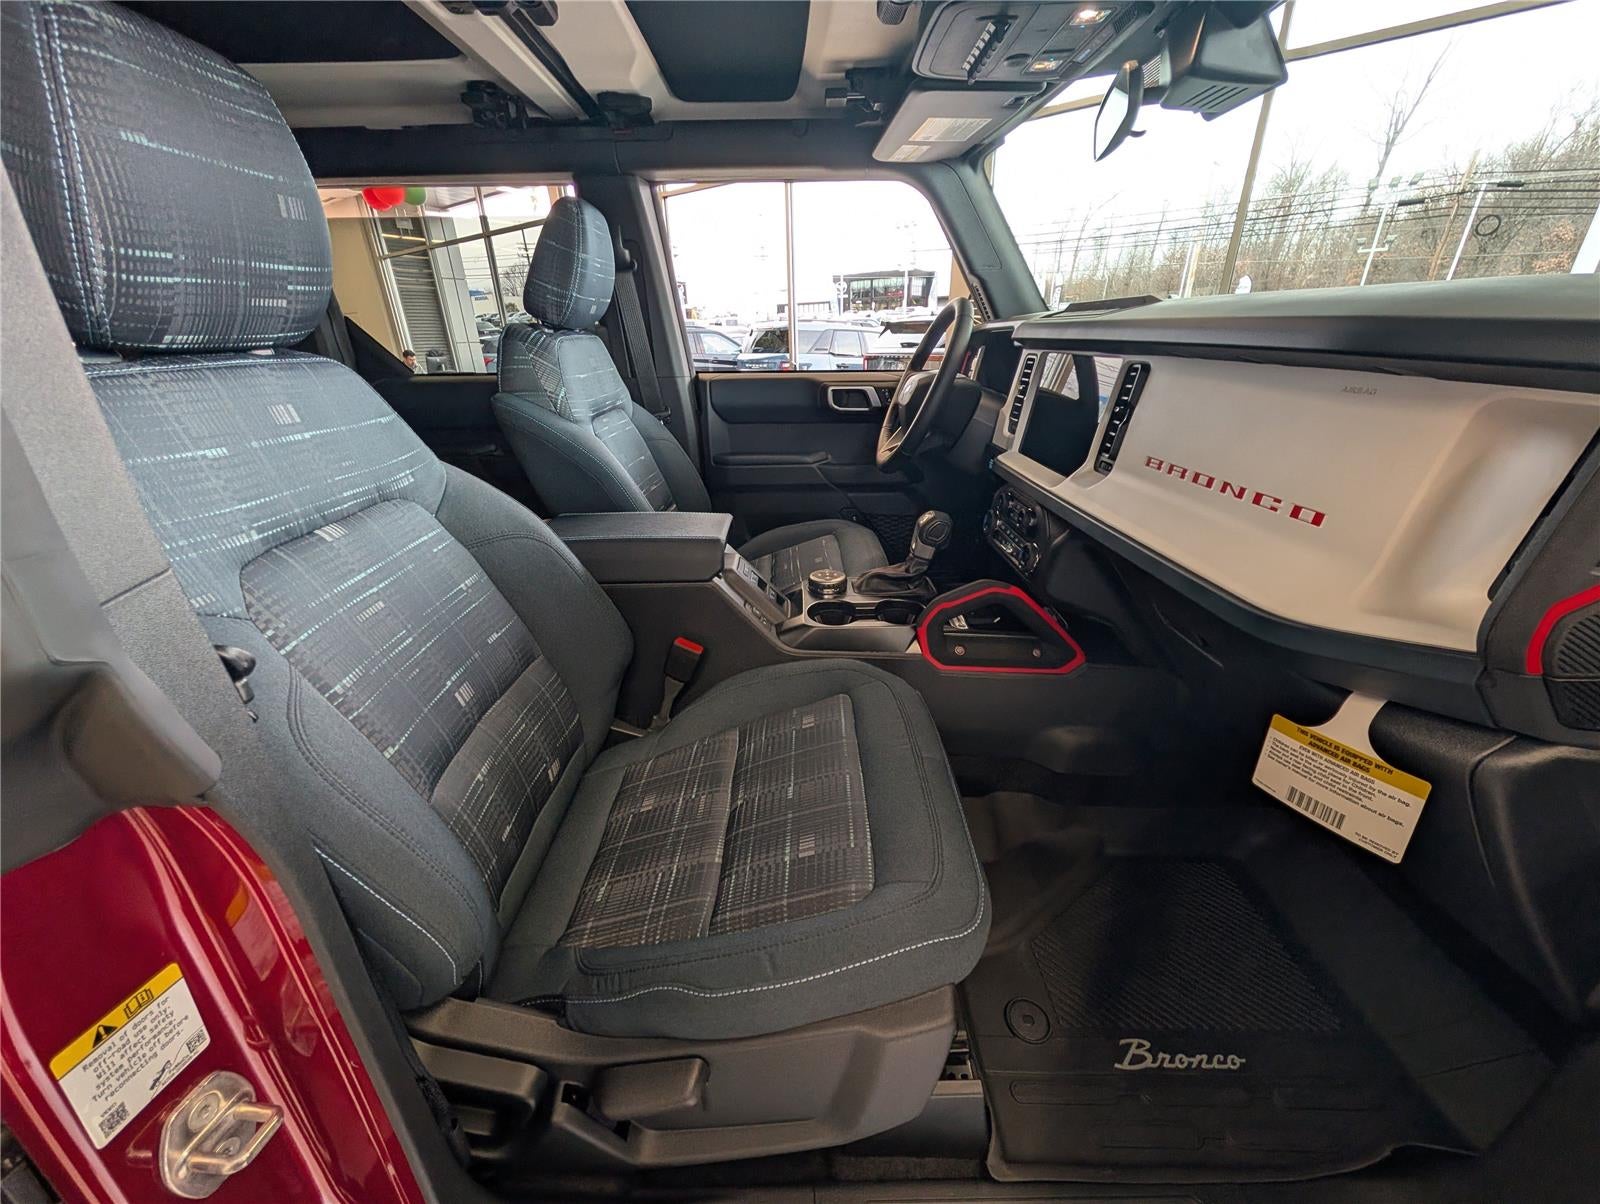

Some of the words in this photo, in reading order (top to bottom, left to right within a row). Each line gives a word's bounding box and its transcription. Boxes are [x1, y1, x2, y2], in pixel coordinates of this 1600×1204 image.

[1144, 455, 1327, 528] BRONCO
[1307, 740, 1339, 758] ADVANCED
[1340, 755, 1351, 764] AIR
[1351, 760, 1370, 773] BAGS
[1309, 733, 1333, 747] VEHICLE
[1341, 748, 1373, 766] EQUIPPED
[1374, 762, 1393, 775] WITH
[81, 1040, 116, 1072] Removal
[117, 1029, 128, 1042] of
[131, 1009, 154, 1031] doors
[156, 995, 170, 1009] for
[91, 1038, 131, 1073] off-road
[133, 1024, 147, 1038] use
[149, 1003, 171, 1024] only.
[91, 1081, 112, 1103] Turn
[114, 1050, 147, 1082] vehicle
[148, 1037, 161, 1052] off
[164, 1013, 189, 1038] before
[95, 1059, 116, 1080] Will
[118, 1033, 146, 1060] affect
[148, 1008, 175, 1034] safety
[95, 1062, 125, 1091] system
[126, 1016, 177, 1063] performance.
[103, 1050, 158, 1101] reconnecting
[159, 1026, 184, 1050] doors.
[1113, 1037, 1246, 1071] Bronco
